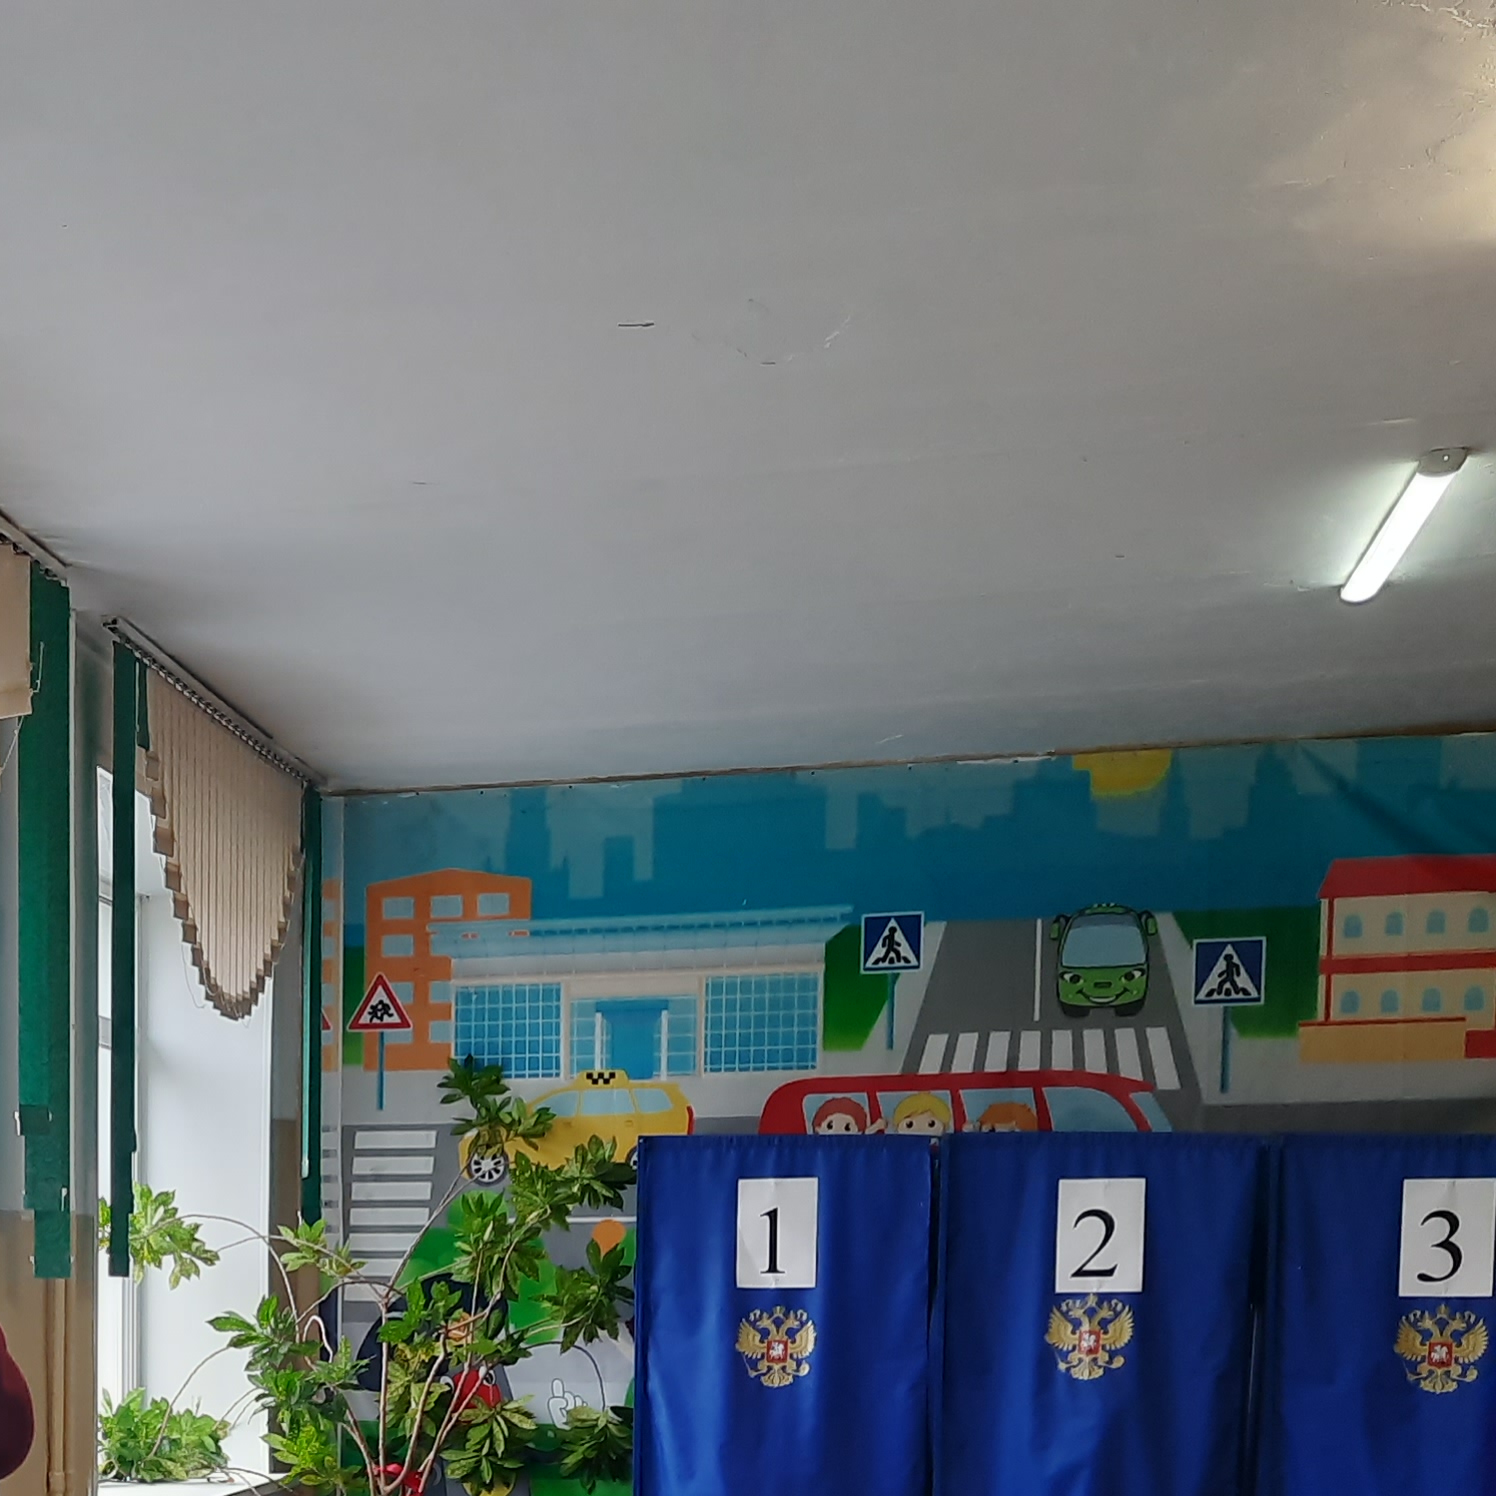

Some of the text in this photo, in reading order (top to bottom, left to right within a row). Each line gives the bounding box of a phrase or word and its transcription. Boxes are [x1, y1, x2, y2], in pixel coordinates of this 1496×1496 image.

[760, 1207, 785, 1274] 1
[1070, 1208, 1118, 1278] 2
[1416, 1209, 1463, 1283] 3
